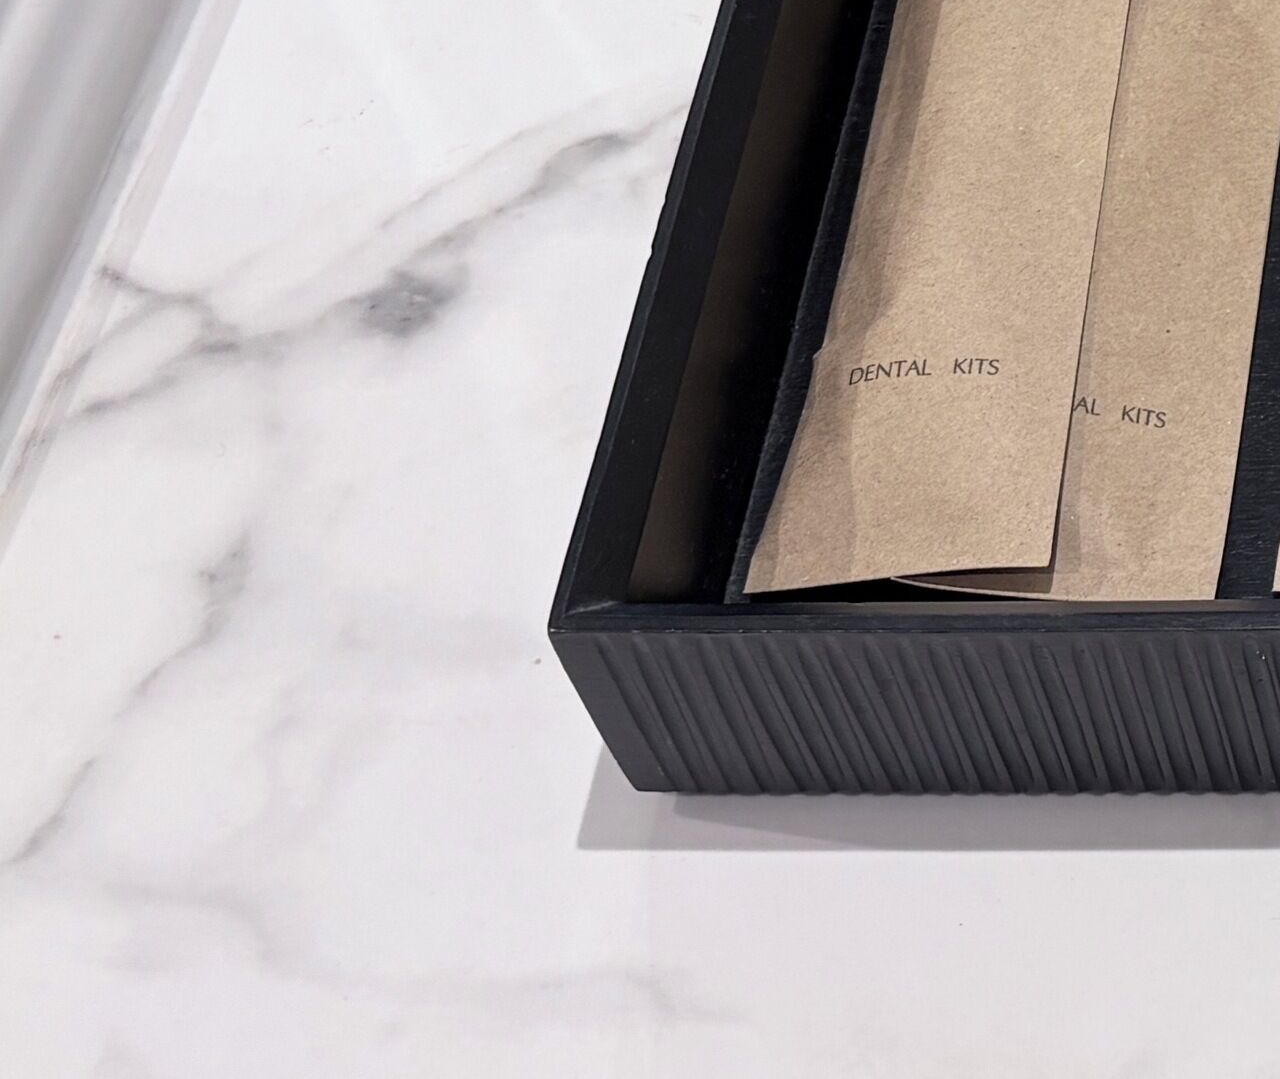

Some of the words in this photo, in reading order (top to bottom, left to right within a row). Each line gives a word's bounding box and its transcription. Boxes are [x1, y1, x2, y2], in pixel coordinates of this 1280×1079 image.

[848, 358, 932, 386] DENTAL
[952, 358, 1000, 375] KITS
[1120, 404, 1167, 428] KITS
